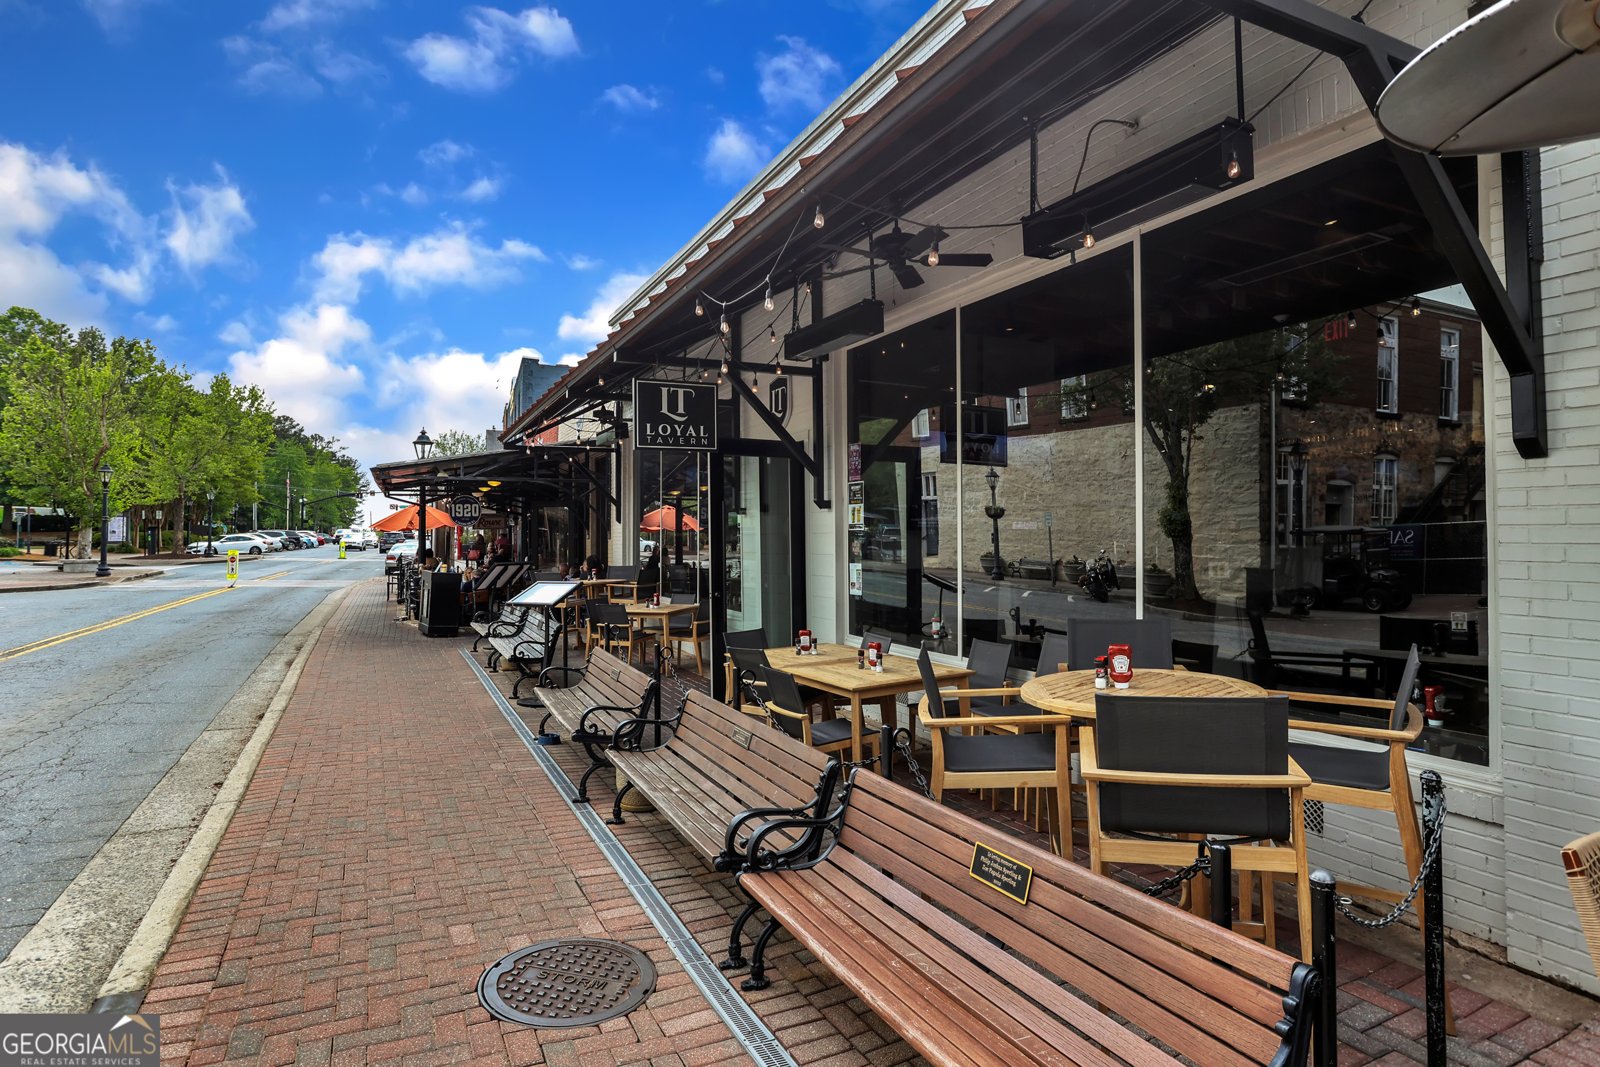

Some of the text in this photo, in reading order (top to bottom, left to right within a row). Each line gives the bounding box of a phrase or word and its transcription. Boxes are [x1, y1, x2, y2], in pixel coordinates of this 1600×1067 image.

[1324, 319, 1348, 342] EXIT
[659, 386, 695, 422] LT
[646, 423, 708, 437] LOYAL
[647, 436, 708, 445] TAVERN
[451, 503, 479, 517] 1920
[536, 970, 608, 990] STORM
